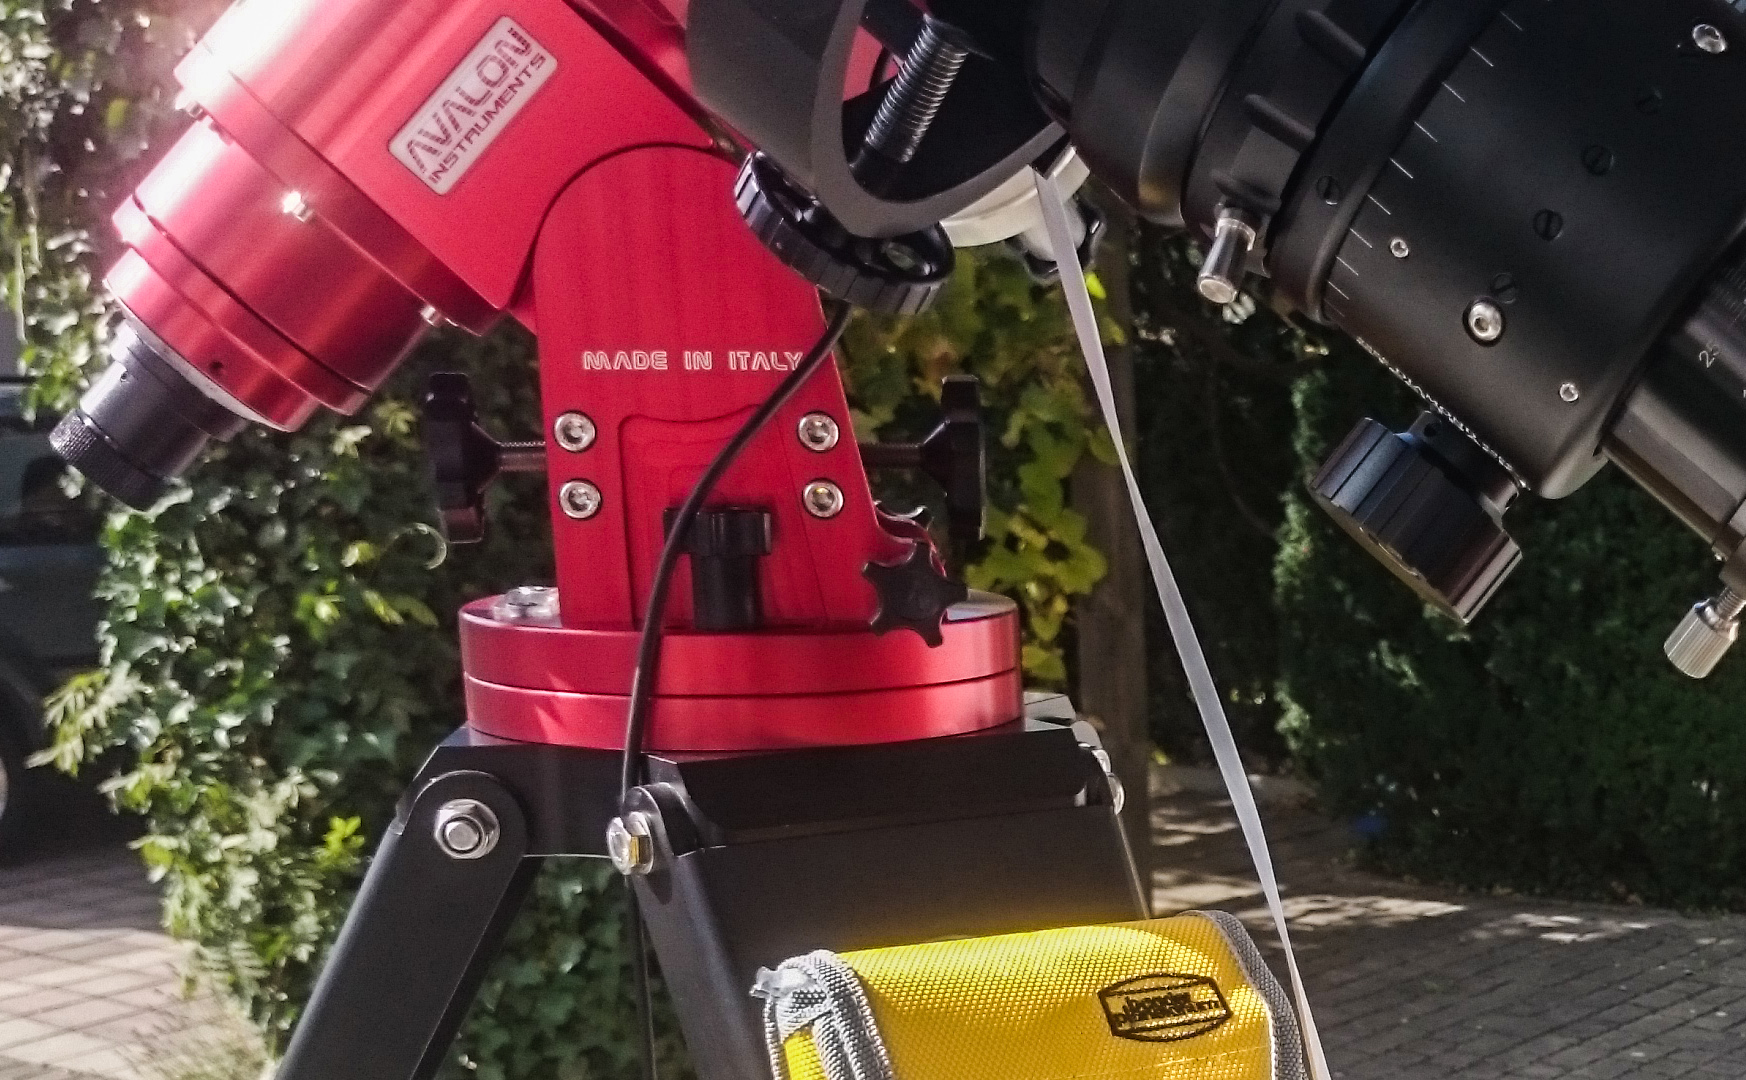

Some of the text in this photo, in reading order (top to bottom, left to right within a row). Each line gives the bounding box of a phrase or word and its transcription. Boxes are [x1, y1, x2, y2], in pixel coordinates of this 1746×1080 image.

[407, 27, 532, 174] AVALON
[428, 53, 546, 184] INSTRUMENTS
[583, 351, 803, 371] MADE IN ITALY
